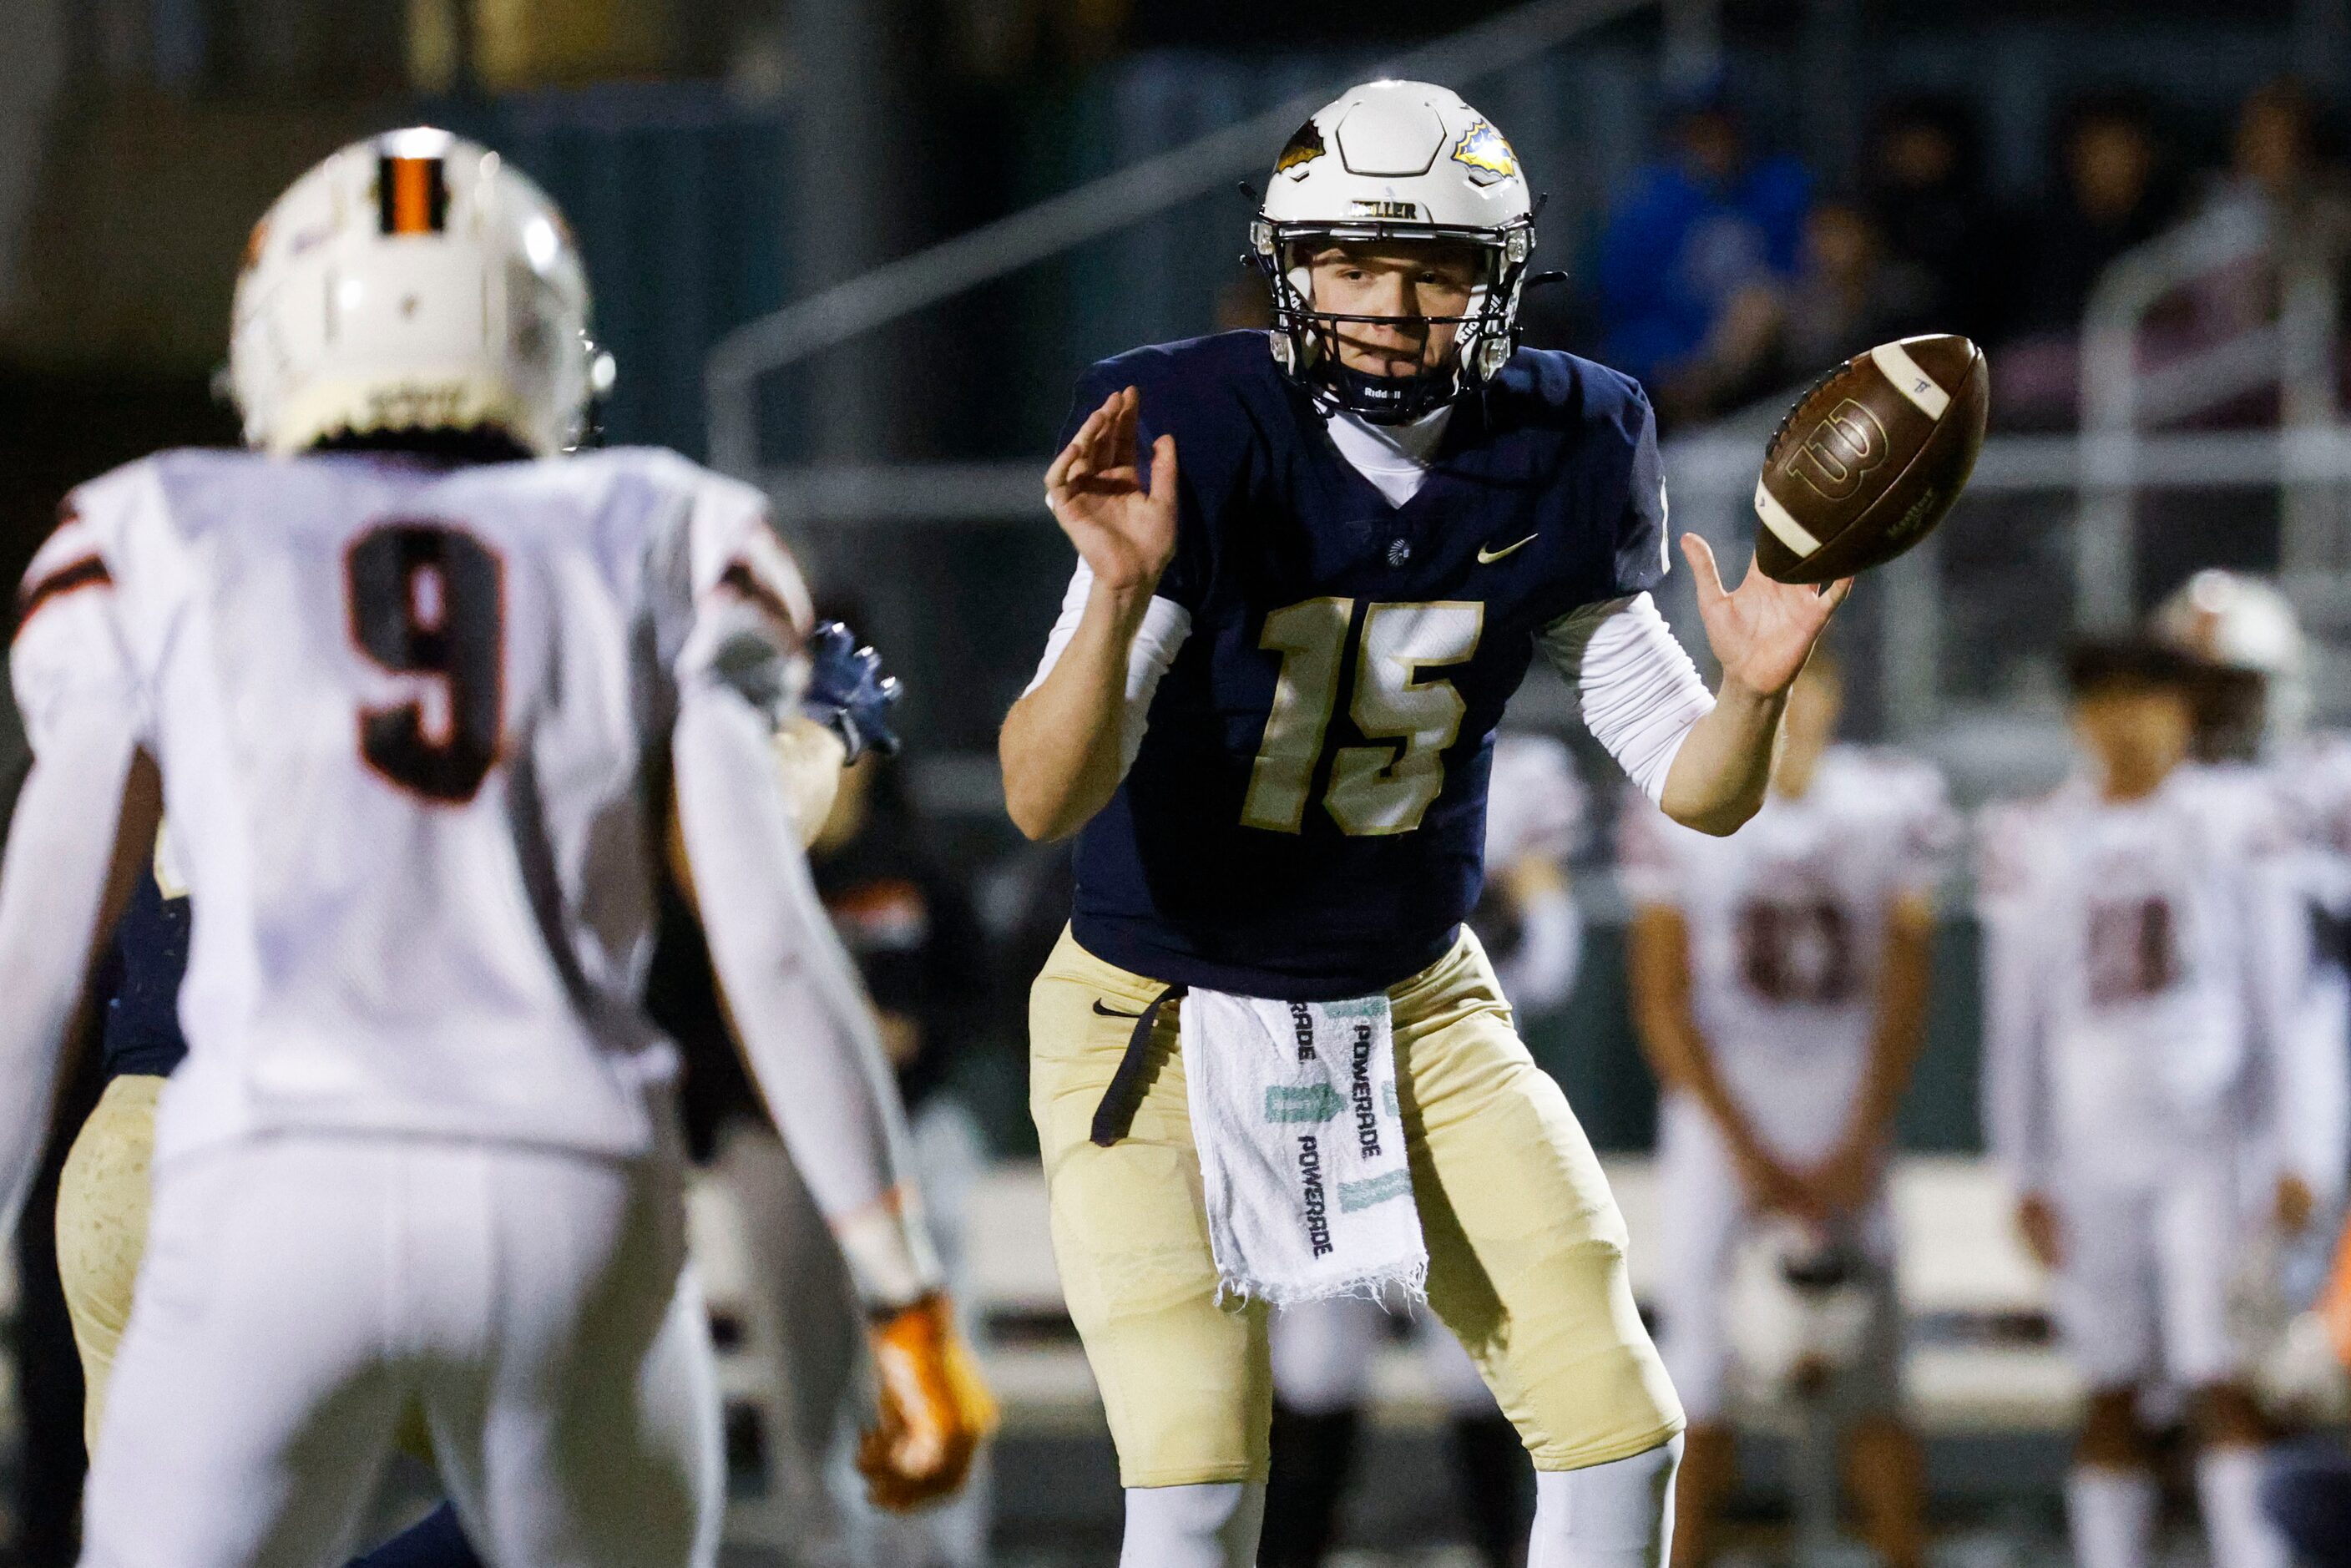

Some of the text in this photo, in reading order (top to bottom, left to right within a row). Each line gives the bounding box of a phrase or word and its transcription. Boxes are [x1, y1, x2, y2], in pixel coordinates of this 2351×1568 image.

[1351, 200, 1418, 220] LLER
[1365, 387, 1401, 399] Riddll
[341, 518, 508, 807] 9
[1239, 596, 1484, 836] 15
[1352, 1024, 1382, 1161] POWERADE
[1297, 1135, 1333, 1260] POWERADE
